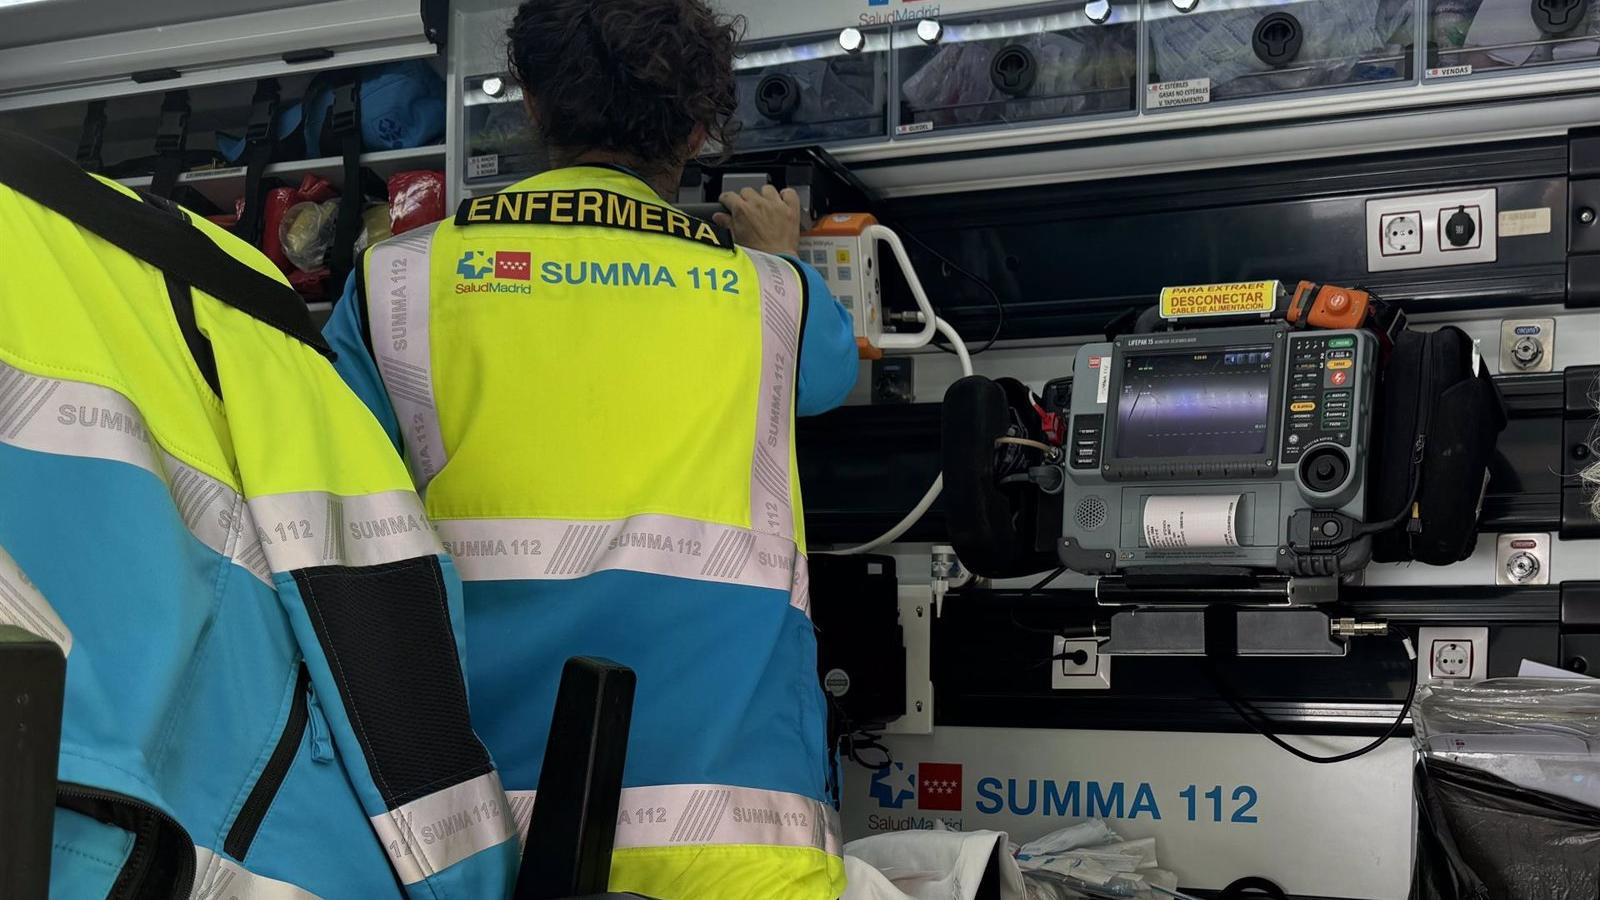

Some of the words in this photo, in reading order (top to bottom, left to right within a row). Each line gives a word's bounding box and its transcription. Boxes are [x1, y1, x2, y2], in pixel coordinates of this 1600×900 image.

[859, 4, 941, 26] SaludMadrid
[1441, 67, 1468, 75] VENDAS
[468, 189, 720, 246] ENFERMERA
[392, 257, 408, 282] 112
[541, 262, 676, 288] SUMMA
[687, 267, 740, 295] 112
[455, 282, 531, 295] SaludMadrid
[1171, 292, 1263, 307] DESCONECTAR
[1207, 283, 1264, 293] EXTRAER
[392, 283, 408, 351] SUMMA
[1171, 306, 1197, 315] CABLE
[1208, 302, 1264, 313] ALIMENTACIÓN
[774, 352, 785, 382] 112
[768, 384, 783, 448] SUMMA
[274, 519, 314, 542] 112
[350, 514, 421, 540] SUMMA
[442, 539, 508, 557] SUMMA
[510, 540, 542, 555] 112
[607, 533, 674, 551] SUMMA
[677, 538, 702, 556] 112
[975, 777, 1162, 820] SUMMA
[1179, 784, 1259, 824] 112
[420, 810, 475, 845] SUMMA
[472, 800, 500, 823] 112
[635, 808, 667, 824] 112
[732, 807, 783, 826] SUMMA
[783, 812, 808, 826] 112
